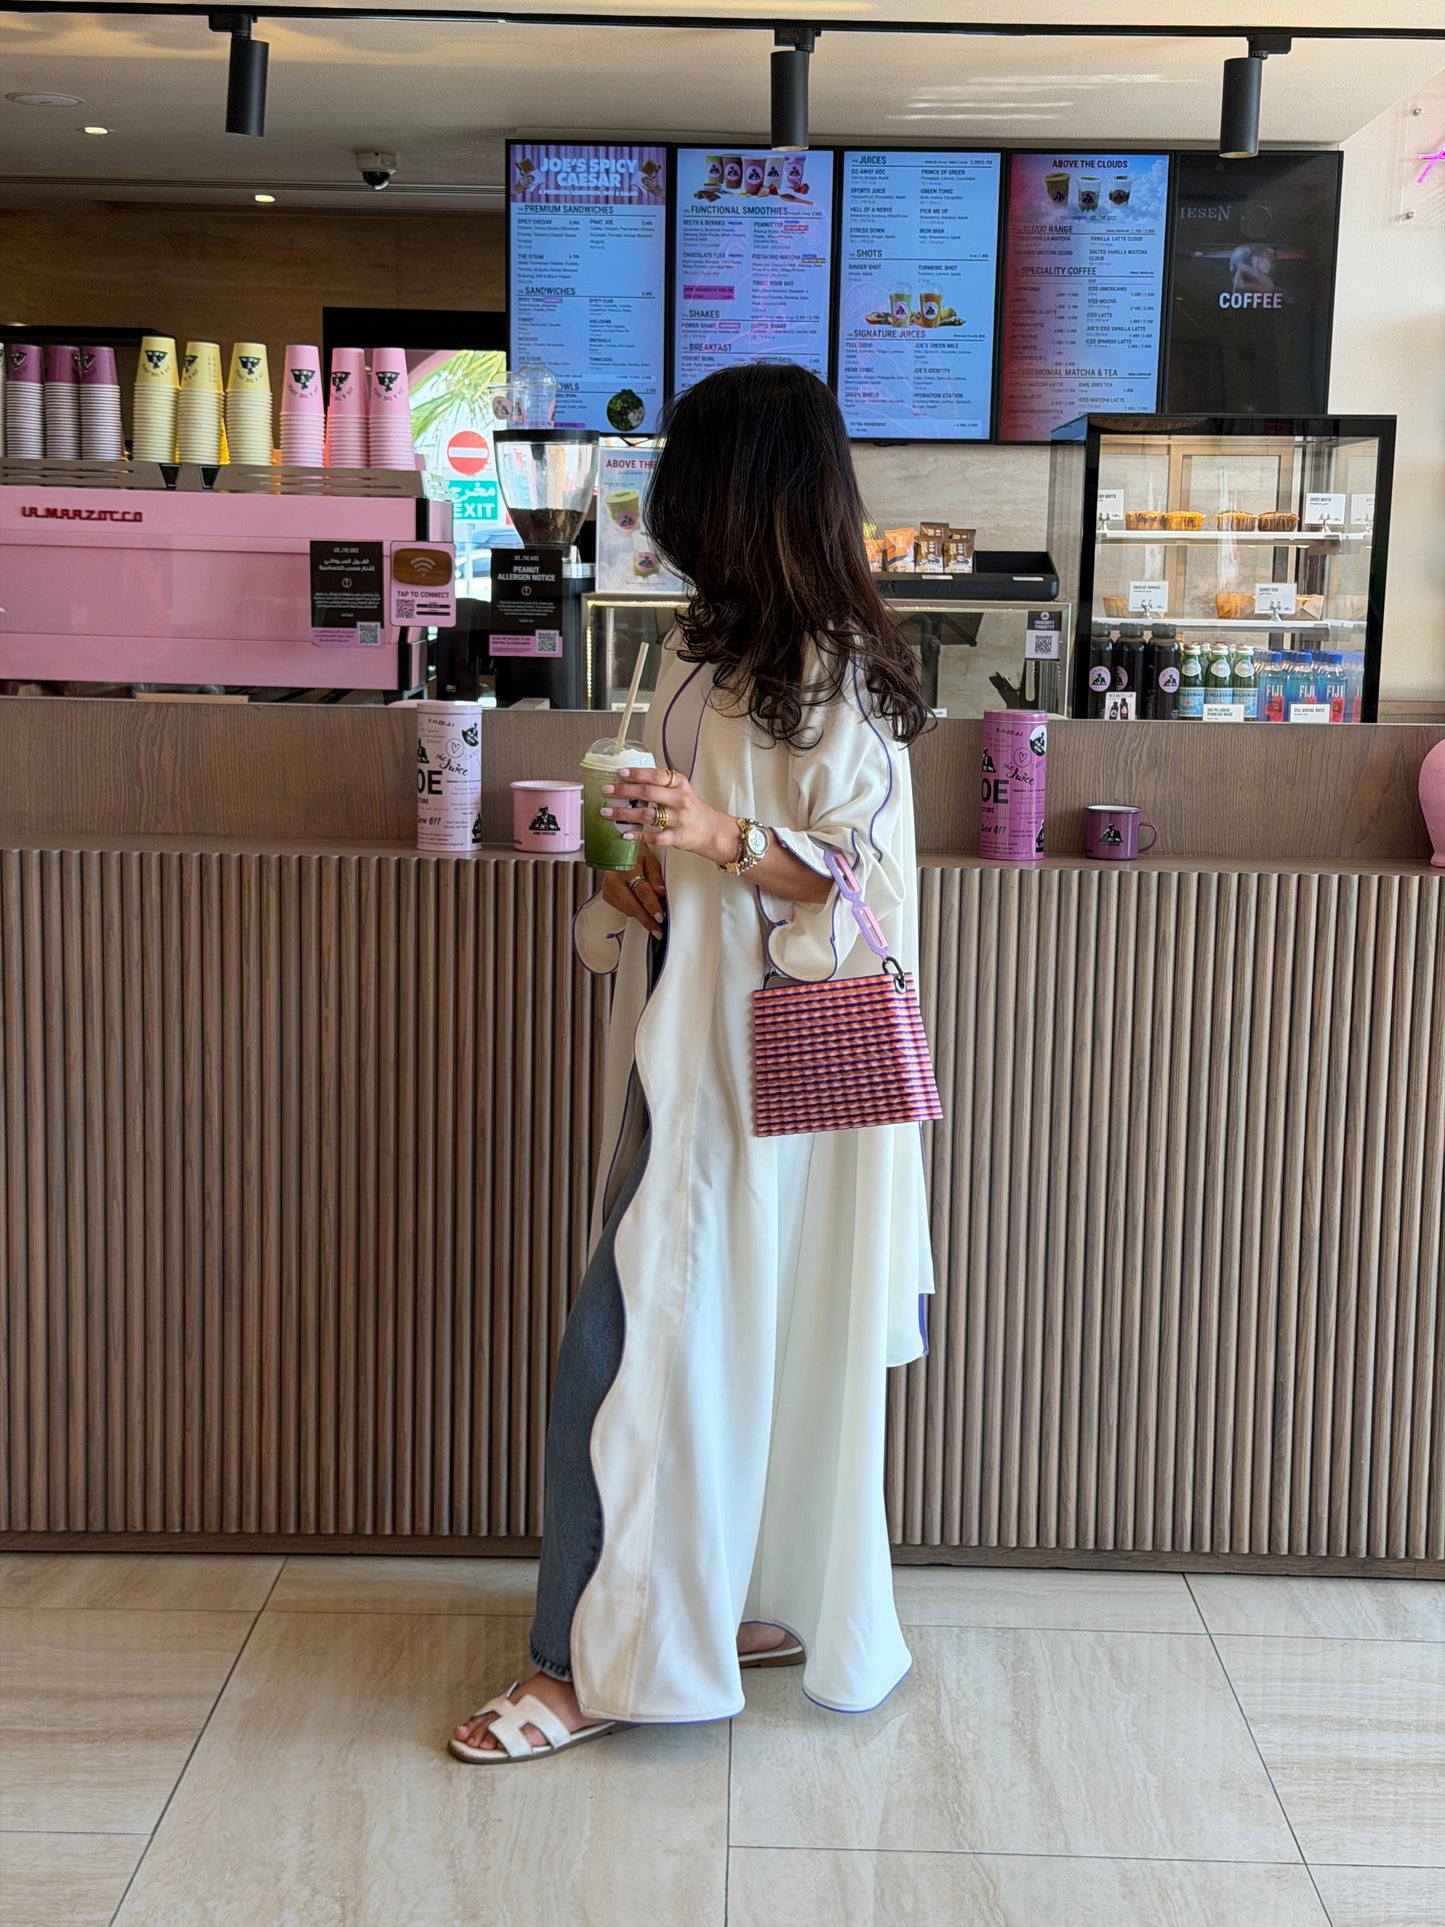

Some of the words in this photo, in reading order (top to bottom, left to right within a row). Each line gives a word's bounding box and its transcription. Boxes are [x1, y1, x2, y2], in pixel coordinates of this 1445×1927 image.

[540, 158, 587, 174] JOE'S
[590, 158, 637, 174] SPICY
[859, 156, 887, 165] JUICES
[1052, 160, 1079, 169] ABOVE
[1080, 160, 1095, 169] THE
[1098, 160, 1128, 169] CLOUDS
[557, 173, 621, 187] CAESAR
[525, 205, 561, 213] PREMIUM
[563, 206, 614, 214] SANDWICHES
[691, 206, 740, 214] FUNCTIONAL
[743, 207, 788, 215] SMOOTHIES
[1180, 206, 1232, 221] IESEN
[1022, 267, 1066, 275] SPECIALITY
[1068, 267, 1097, 275] COFFEE
[525, 288, 576, 296] SANDWICHES
[1219, 293, 1283, 309] COFFEE
[689, 310, 720, 318] SHAKES
[854, 330, 897, 338] SIGNATURE
[1065, 369, 1096, 377] MATCHA
[1097, 369, 1102, 377] &
[1104, 369, 1118, 377] TEA
[557, 383, 579, 391] OWLS
[606, 460, 637, 468] ABOVE
[450, 482, 496, 503] مخرج
[453, 503, 495, 518] EXIT
[1266, 684, 1283, 697] FIJI
[1300, 685, 1315, 698] FIJI
[1327, 684, 1344, 698] FIJI
[440, 758, 469, 776] Juice
[418, 769, 443, 795] OE
[1006, 767, 1035, 785] Juice
[982, 778, 1009, 804] OE
